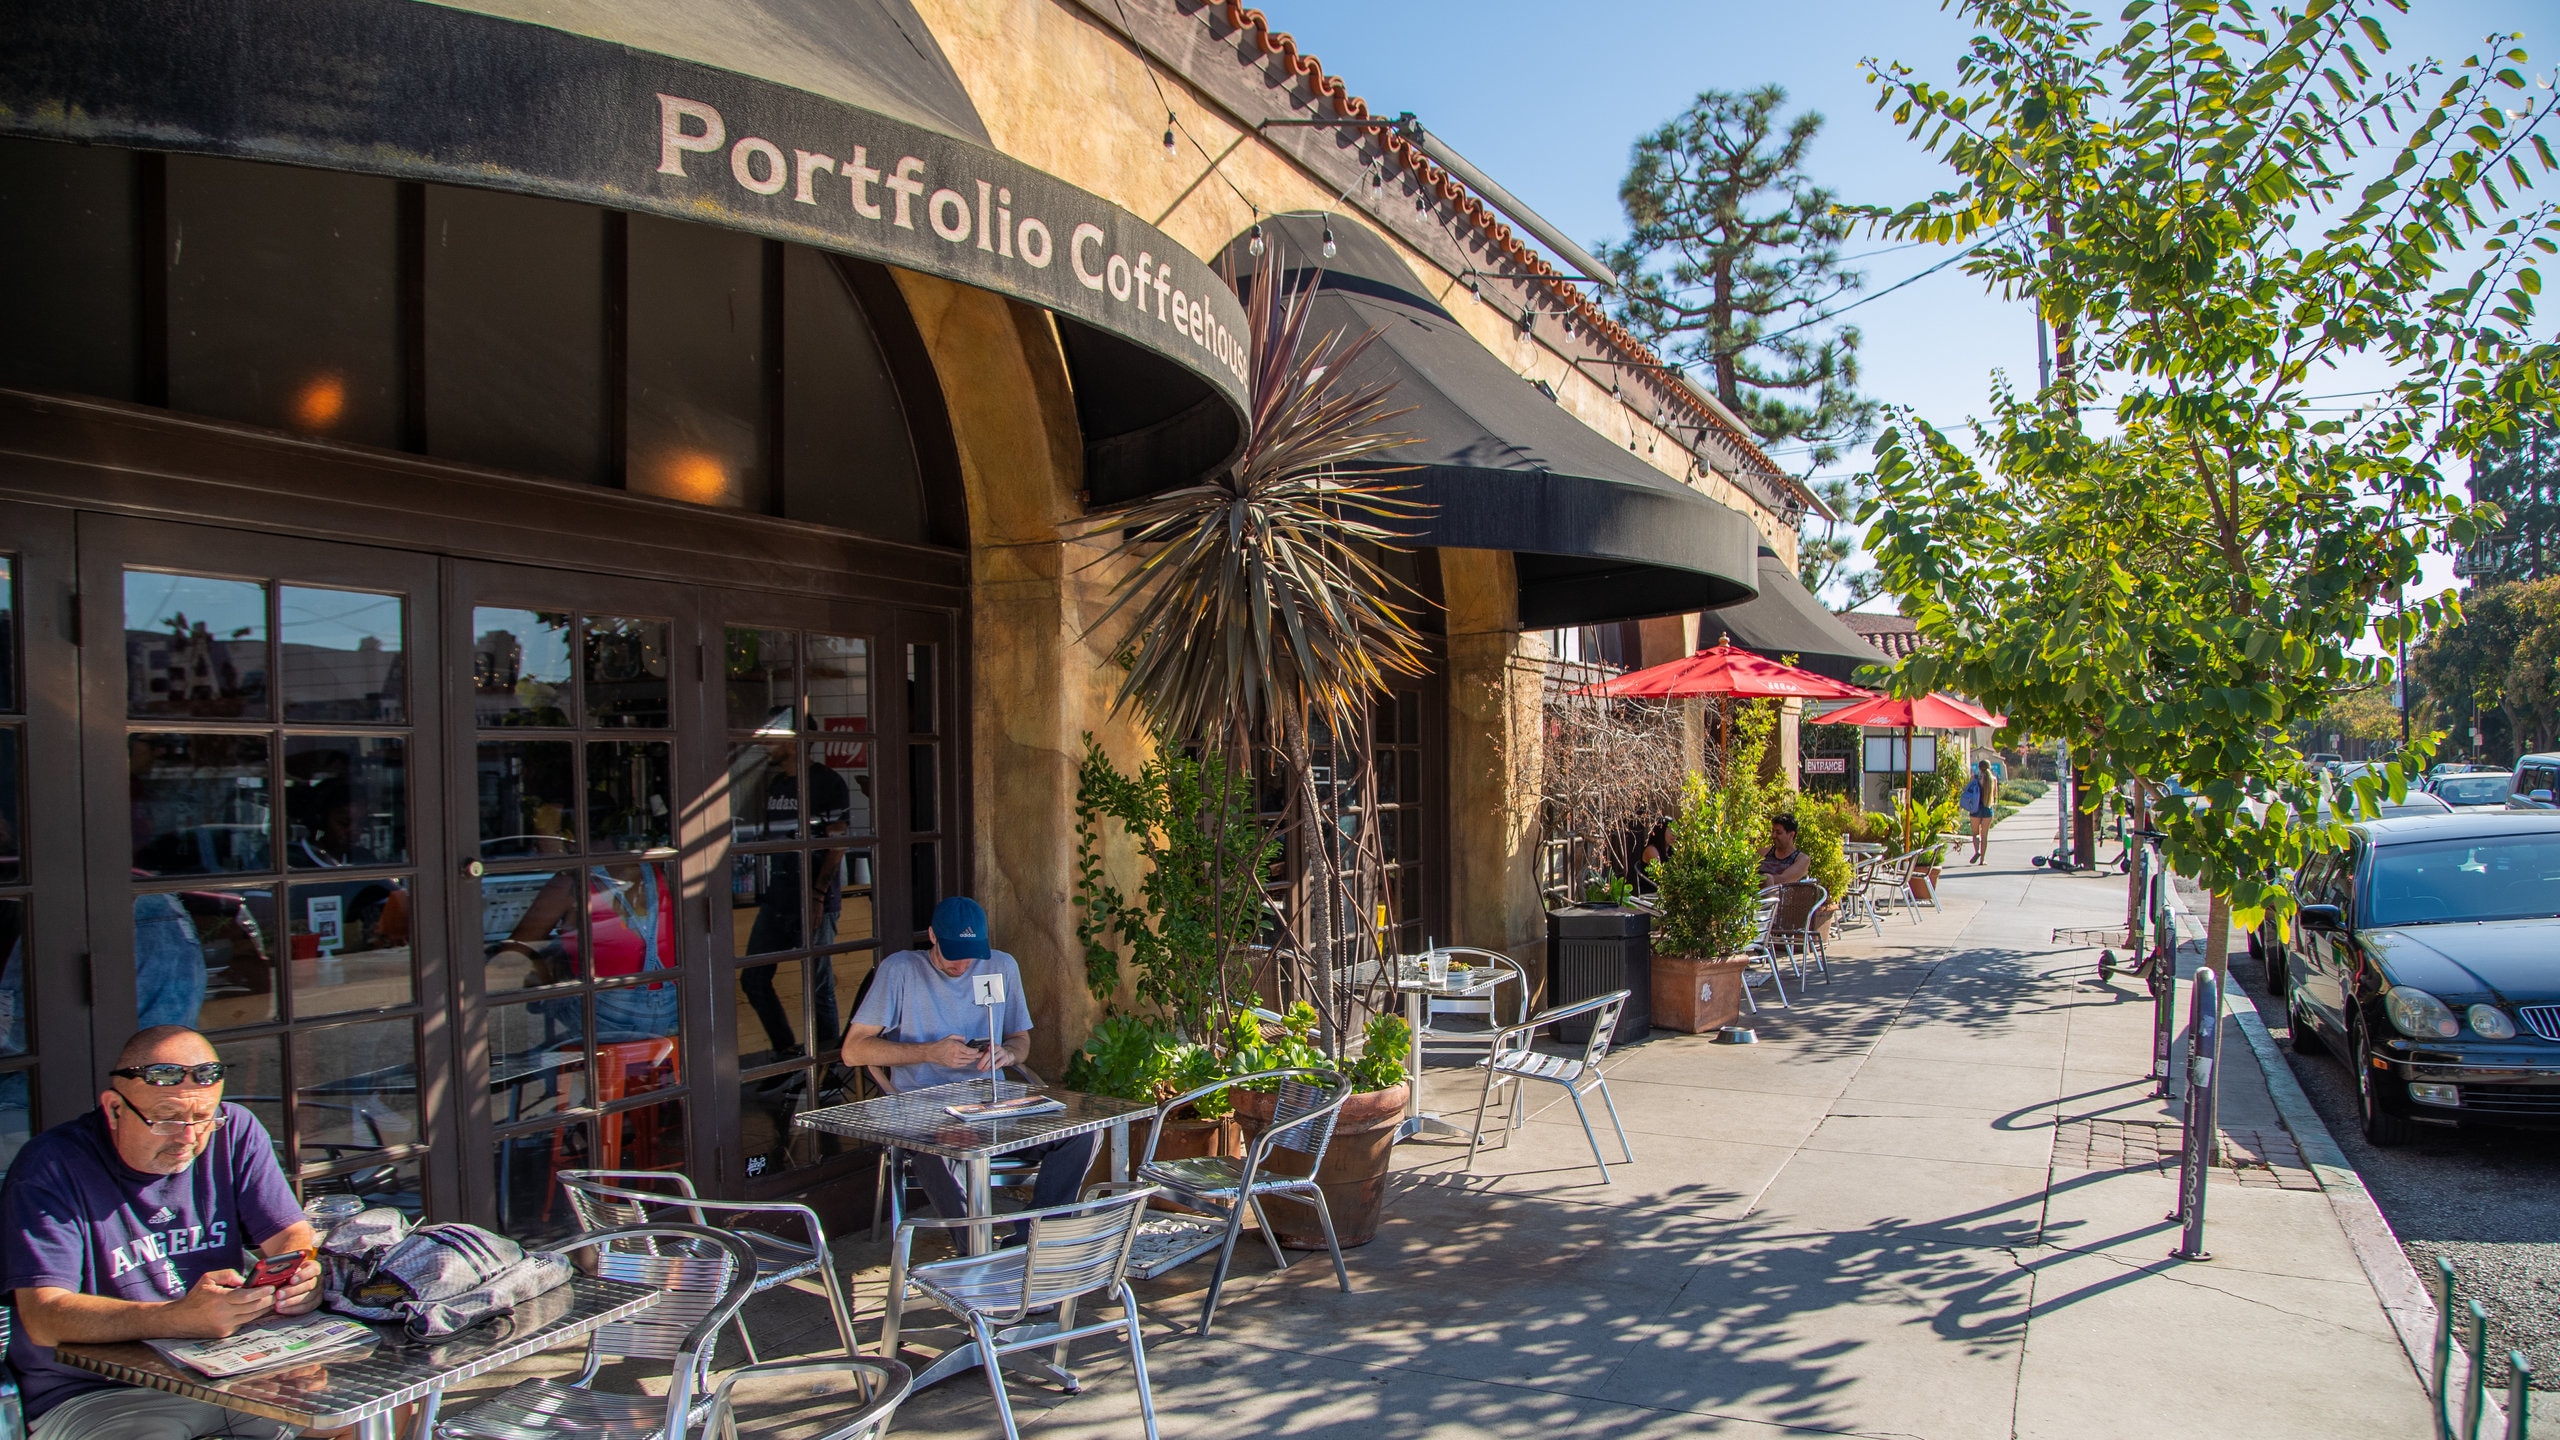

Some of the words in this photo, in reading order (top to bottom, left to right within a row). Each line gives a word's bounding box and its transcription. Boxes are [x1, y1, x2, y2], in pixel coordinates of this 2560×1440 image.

[656, 92, 1053, 269] Portfolio
[1070, 222, 1249, 394] Coffeehouse
[1807, 761, 1843, 771] ENTRANCE
[983, 980, 991, 997] 1
[110, 1220, 227, 1279] ANGELS
